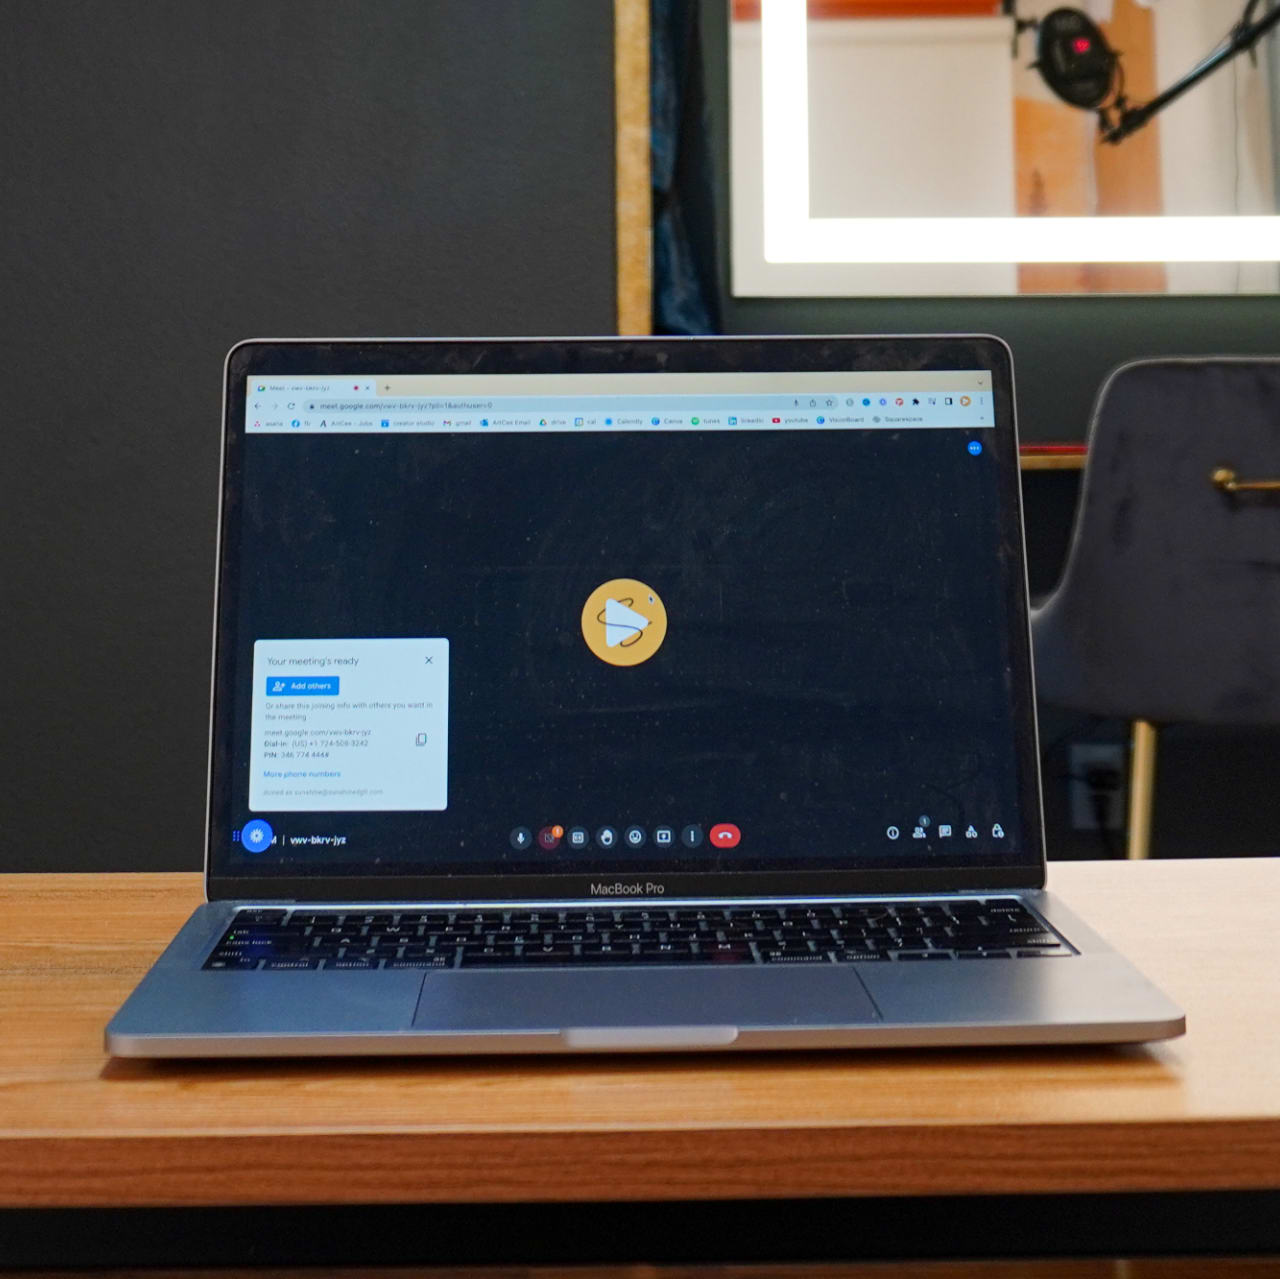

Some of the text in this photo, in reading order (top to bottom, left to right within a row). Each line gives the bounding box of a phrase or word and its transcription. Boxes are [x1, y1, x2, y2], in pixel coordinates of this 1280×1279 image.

[267, 656, 360, 668] Your meeting's ready
[291, 681, 332, 690] Add others
[265, 702, 274, 710] Or
[296, 701, 310, 709] this
[311, 702, 336, 711] joining
[352, 701, 368, 709] with
[369, 701, 391, 709] others
[393, 702, 406, 711] you
[407, 701, 425, 709] want
[278, 713, 307, 722] meeting
[263, 770, 342, 780] More phone numbers
[590, 882, 665, 895] MacBook Pro
